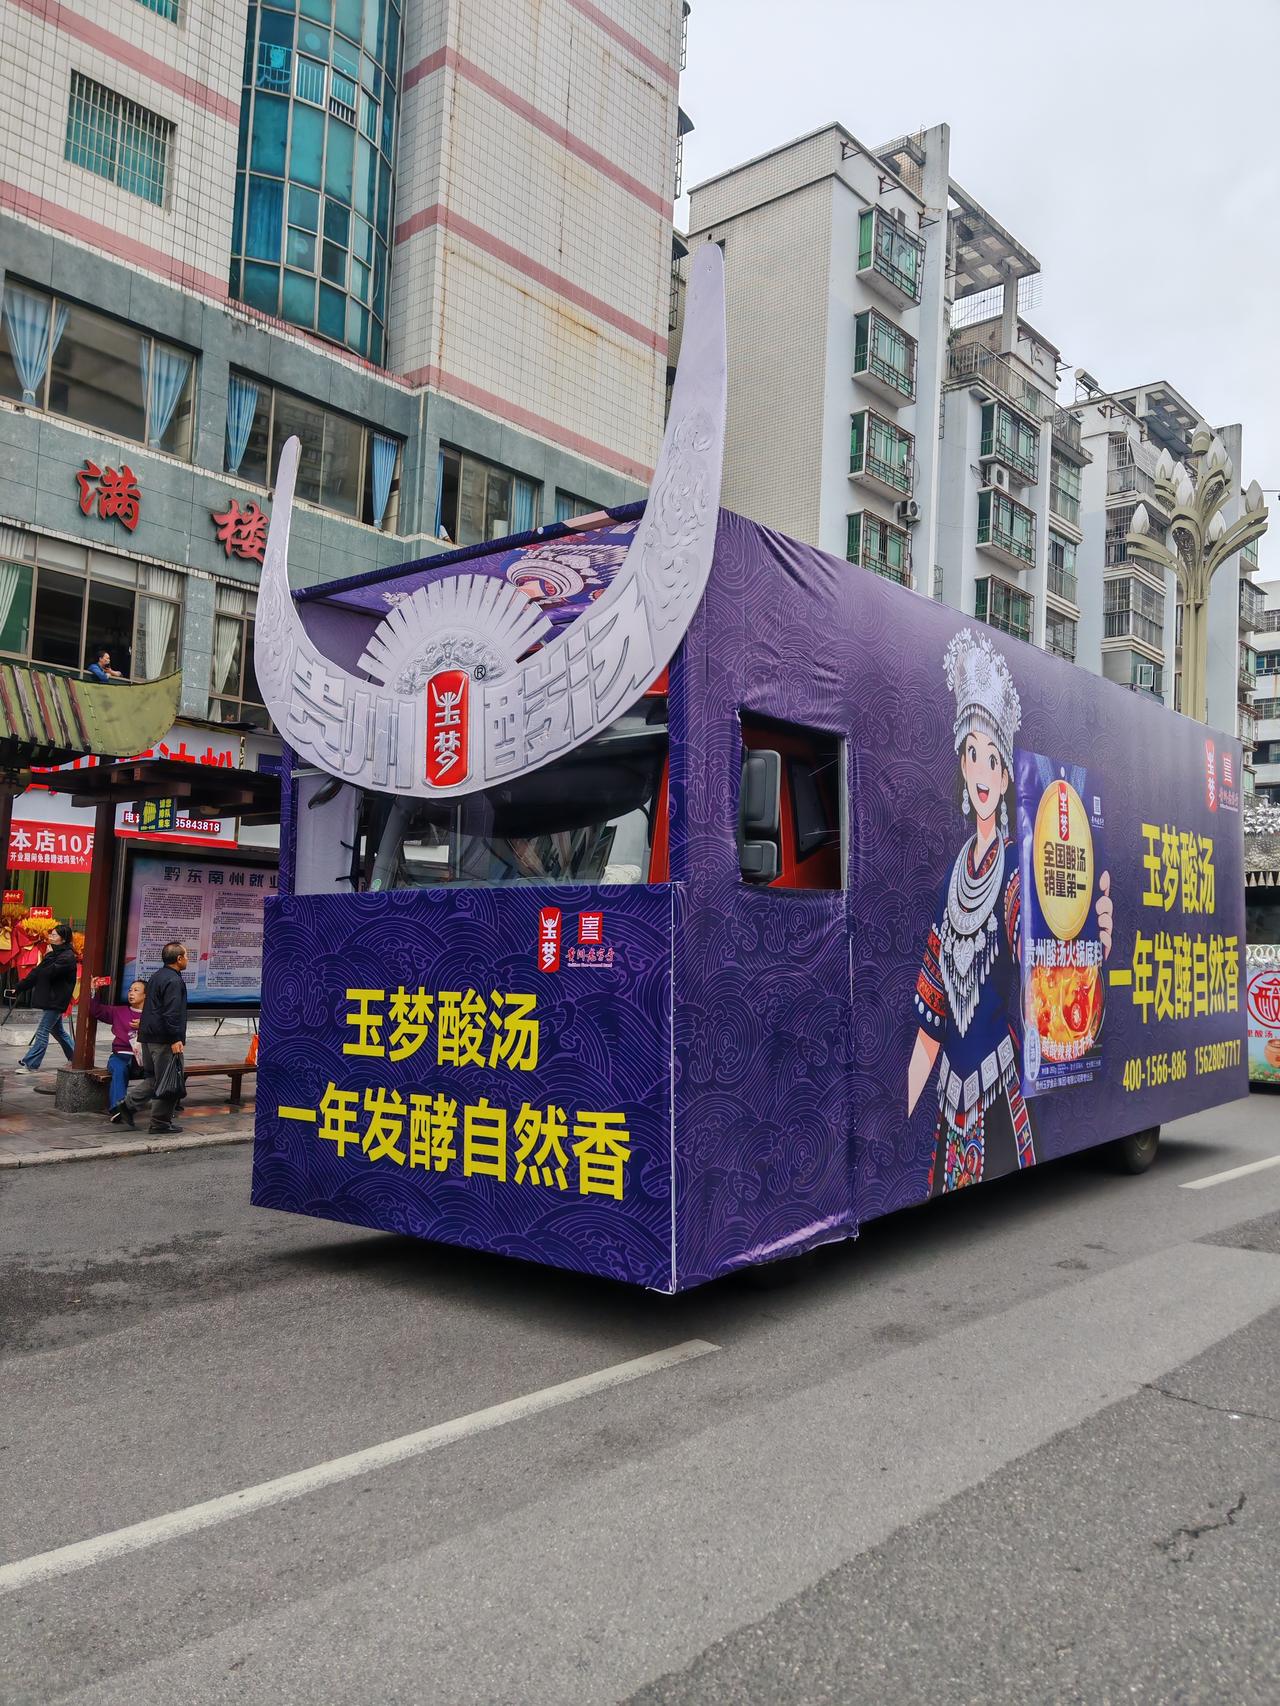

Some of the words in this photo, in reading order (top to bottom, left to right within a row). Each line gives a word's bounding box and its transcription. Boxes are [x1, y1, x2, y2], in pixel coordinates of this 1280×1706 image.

[431, 681, 466, 782] 玉梦
[1044, 841, 1086, 872] 全国酸汤
[1044, 868, 1086, 898] 销量第一
[1141, 823, 1215, 914] 玉梦酸汤
[541, 911, 560, 970] 玉梦
[1024, 938, 1103, 968] 贵州酸汤火锅底料
[1109, 930, 1239, 1024] 一年发酵自然香
[343, 987, 539, 1071] 玉梦酸汤
[1123, 1050, 1187, 1092] 400-1566-886
[278, 1082, 631, 1201] 一年发酵自然香
